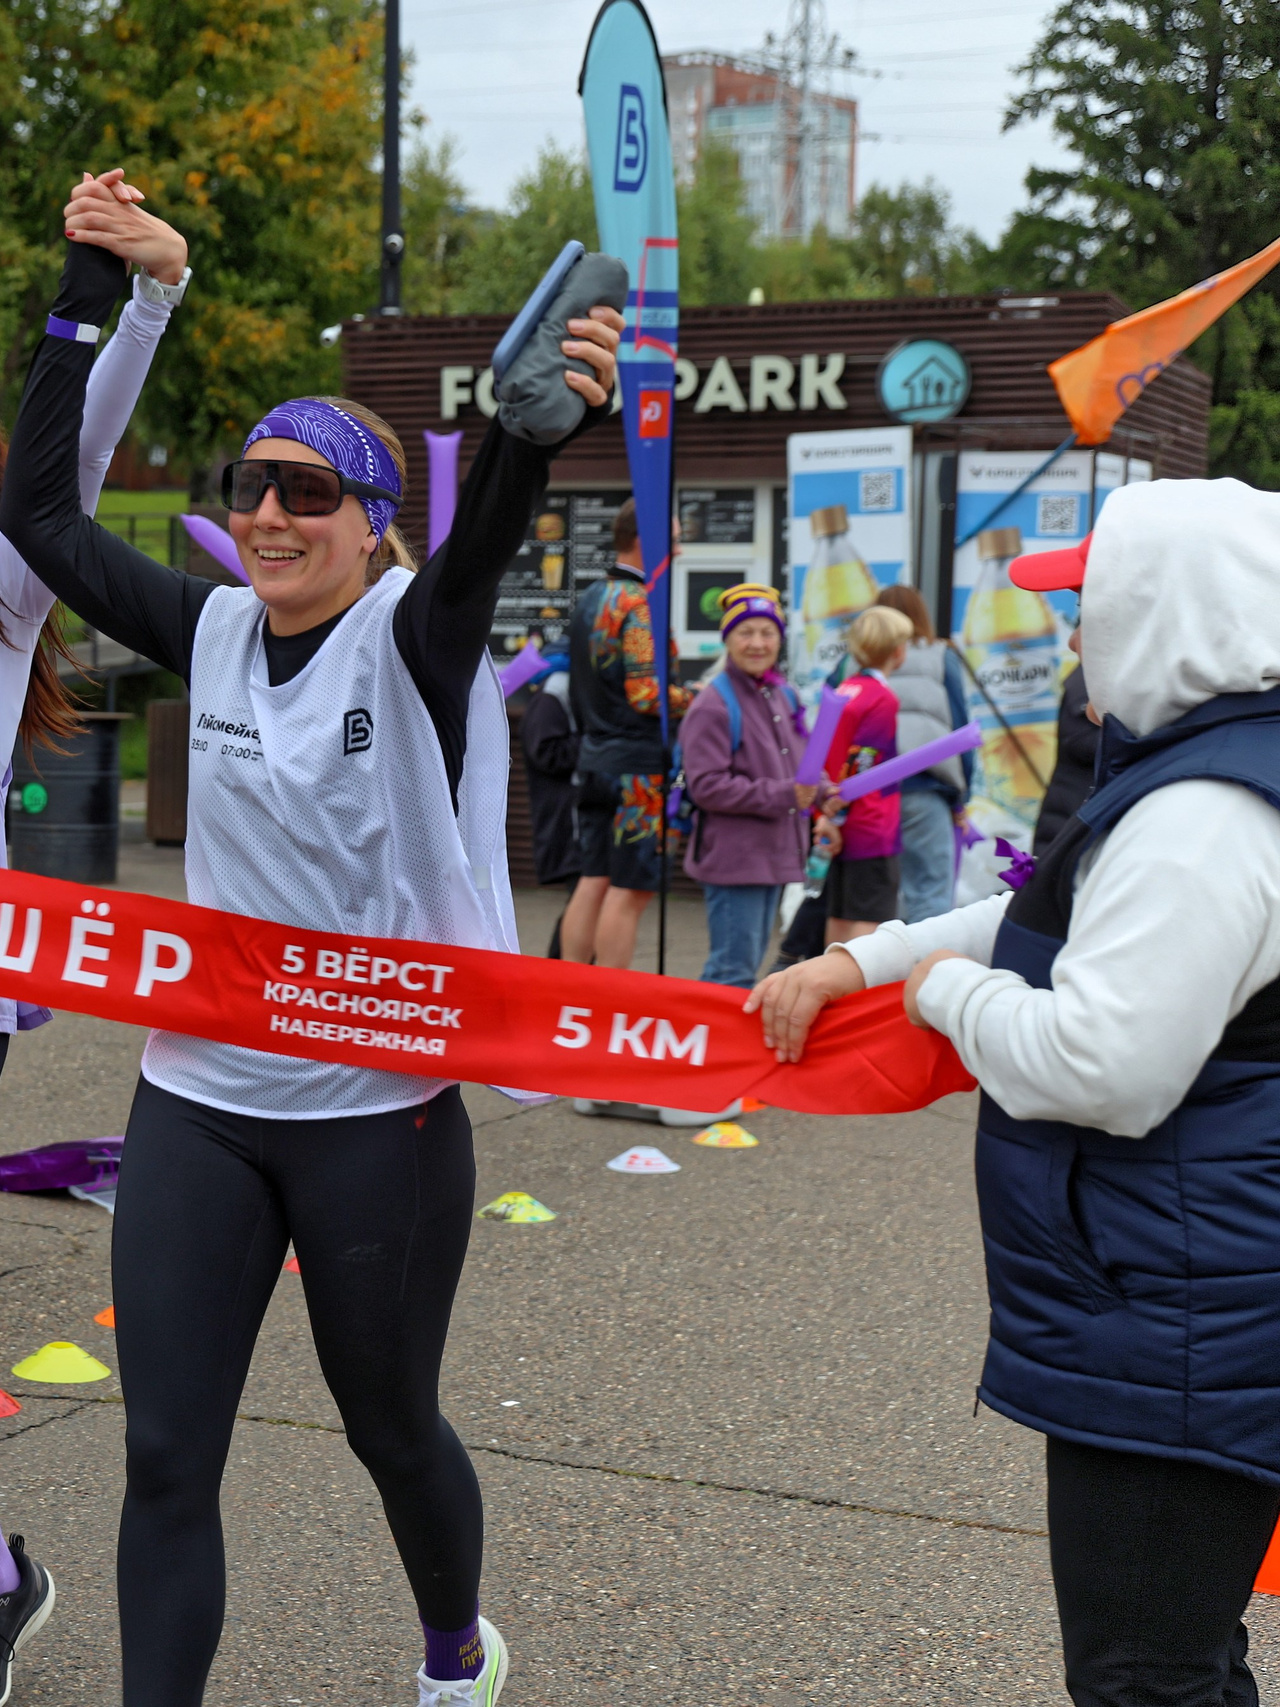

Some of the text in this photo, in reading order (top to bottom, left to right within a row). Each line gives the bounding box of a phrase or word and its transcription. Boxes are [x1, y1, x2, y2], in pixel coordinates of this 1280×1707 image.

[221, 744, 252, 759] 07:00
[281, 944, 455, 994] 5 ВЁРСТ
[263, 979, 464, 1029] КРАСНОЯРСК
[270, 1014, 446, 1056] НАБЕРЕЖНАЯ
[552, 1005, 710, 1067] 5 КМ
